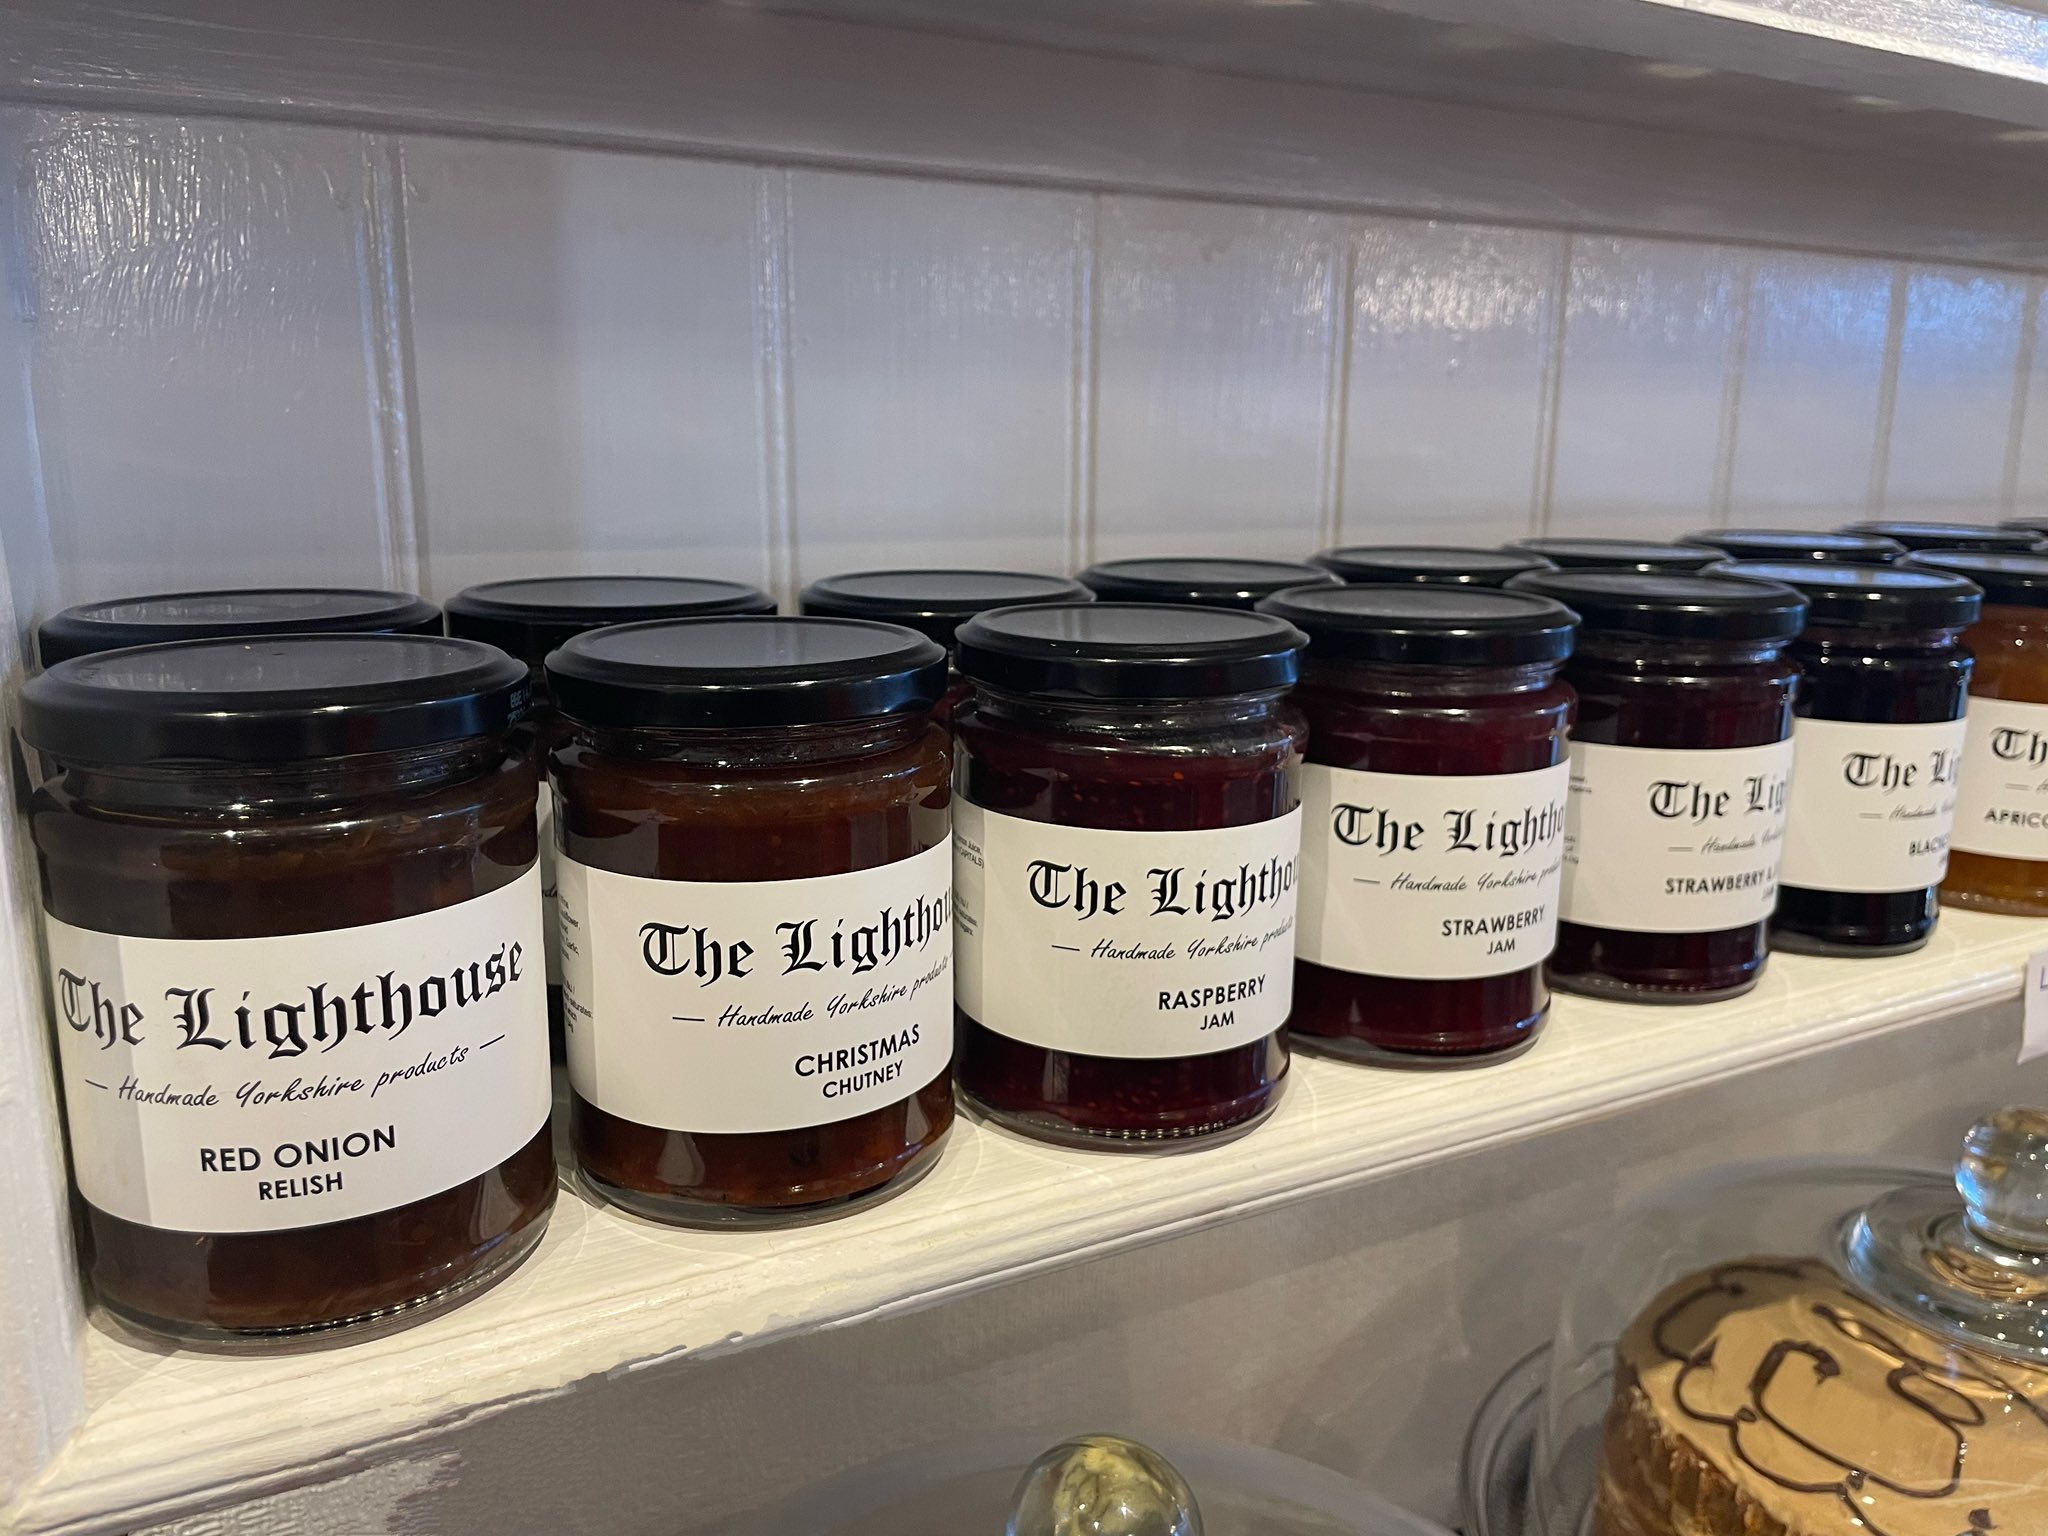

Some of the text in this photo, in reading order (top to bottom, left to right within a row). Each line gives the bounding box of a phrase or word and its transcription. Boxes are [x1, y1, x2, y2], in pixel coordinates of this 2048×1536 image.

[1842, 751, 1919, 794] The
[1647, 779, 1731, 826] The
[1330, 802, 1425, 857] The
[1026, 859, 1127, 922] The
[1390, 871, 1468, 892] Handmade
[1477, 869, 1537, 892] Yorkshire
[1665, 870, 1765, 895] STRAWBERRY
[1441, 905, 1545, 937] STRAWBERRY
[638, 922, 755, 988] The
[1090, 938, 1176, 960] Handmade
[1187, 933, 1259, 960] Yorkshire
[1486, 937, 1516, 956] JAM
[57, 939, 524, 1061] The Lighthouse
[717, 1001, 815, 1028] Handmade
[826, 983, 908, 1019] Yorkshire
[1158, 973, 1266, 1011] RASPBERRY
[1199, 1010, 1235, 1031] JAM
[794, 1023, 920, 1078] CHRISTMAS
[118, 1045, 469, 1108] Handmade Yorkshire products
[821, 1059, 904, 1099] CHUTNEY
[200, 1124, 396, 1173] RED ONION
[258, 1171, 343, 1201] RELISH
